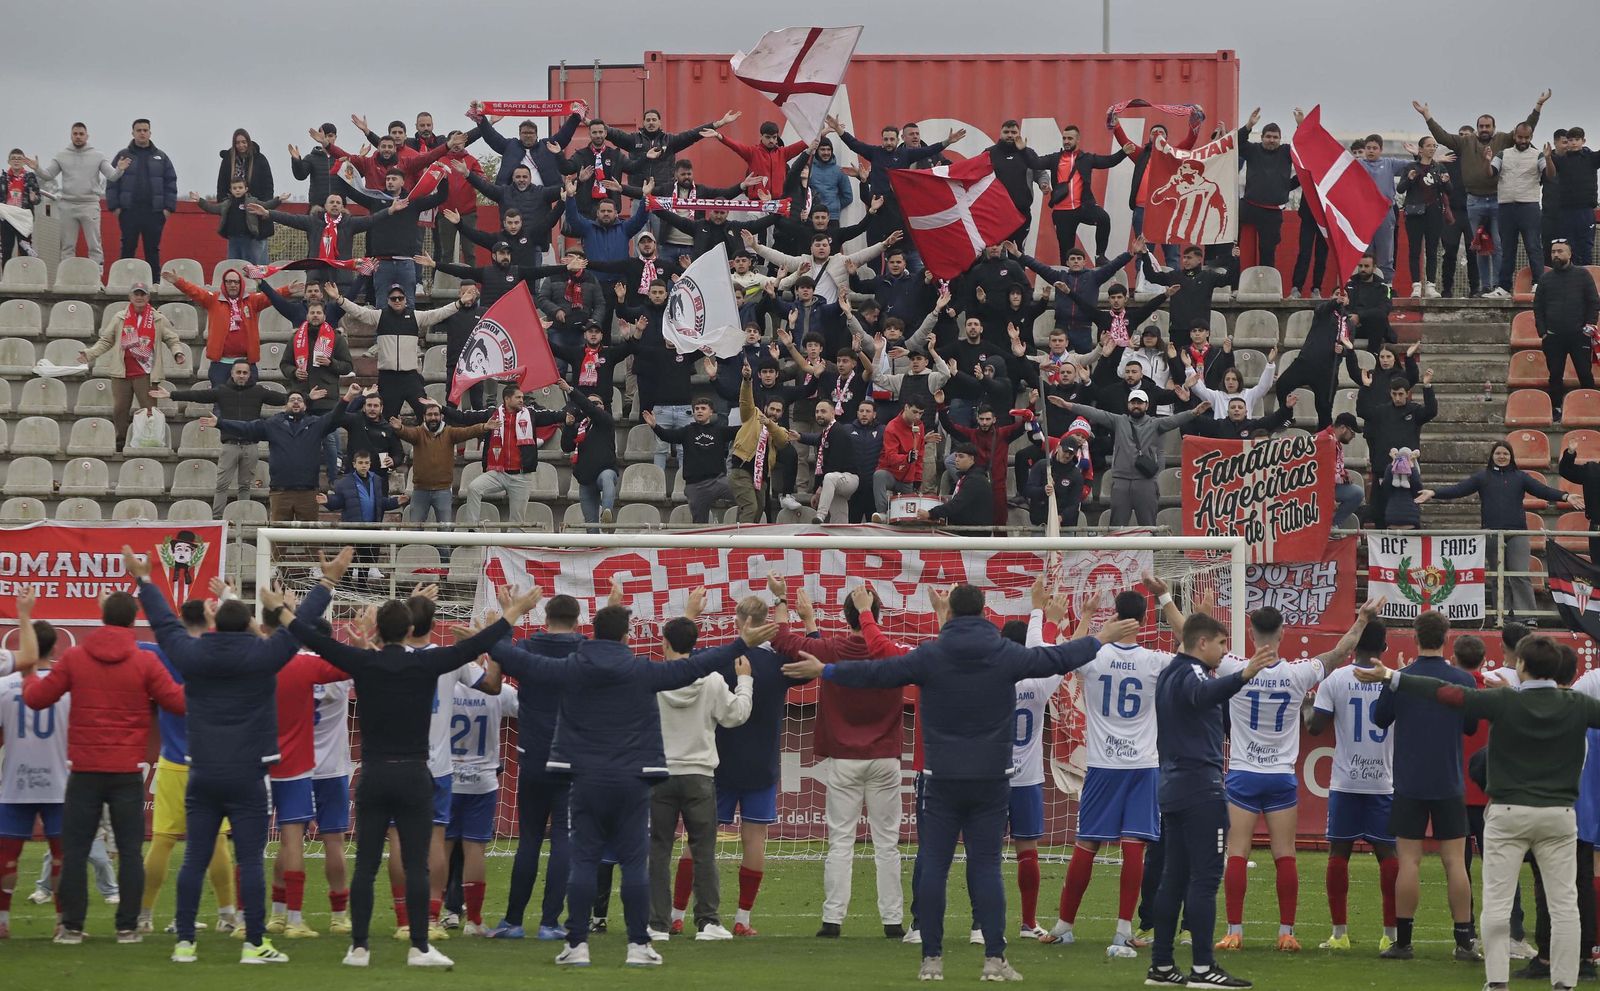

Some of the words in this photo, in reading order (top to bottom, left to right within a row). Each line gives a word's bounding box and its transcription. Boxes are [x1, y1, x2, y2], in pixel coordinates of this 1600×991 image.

[677, 198, 760, 208] ALGECIRAS
[1194, 461, 1318, 528] Algeciras
[1236, 509, 1265, 546] de
[1380, 537, 1408, 555] ACF
[1440, 538, 1476, 557] FANS
[1222, 561, 1337, 587] OUTH
[1380, 569, 1395, 581] 19
[1460, 571, 1474, 582] 12
[1282, 613, 1320, 626] 1912
[1380, 602, 1418, 618] ARRIO
[1018, 691, 1035, 700] AMO
[1098, 674, 1143, 719] 16
[13, 694, 56, 739] 10
[1245, 690, 1291, 732] 17
[1349, 697, 1388, 743] 19
[450, 714, 488, 756] 21
[786, 811, 810, 824] del
